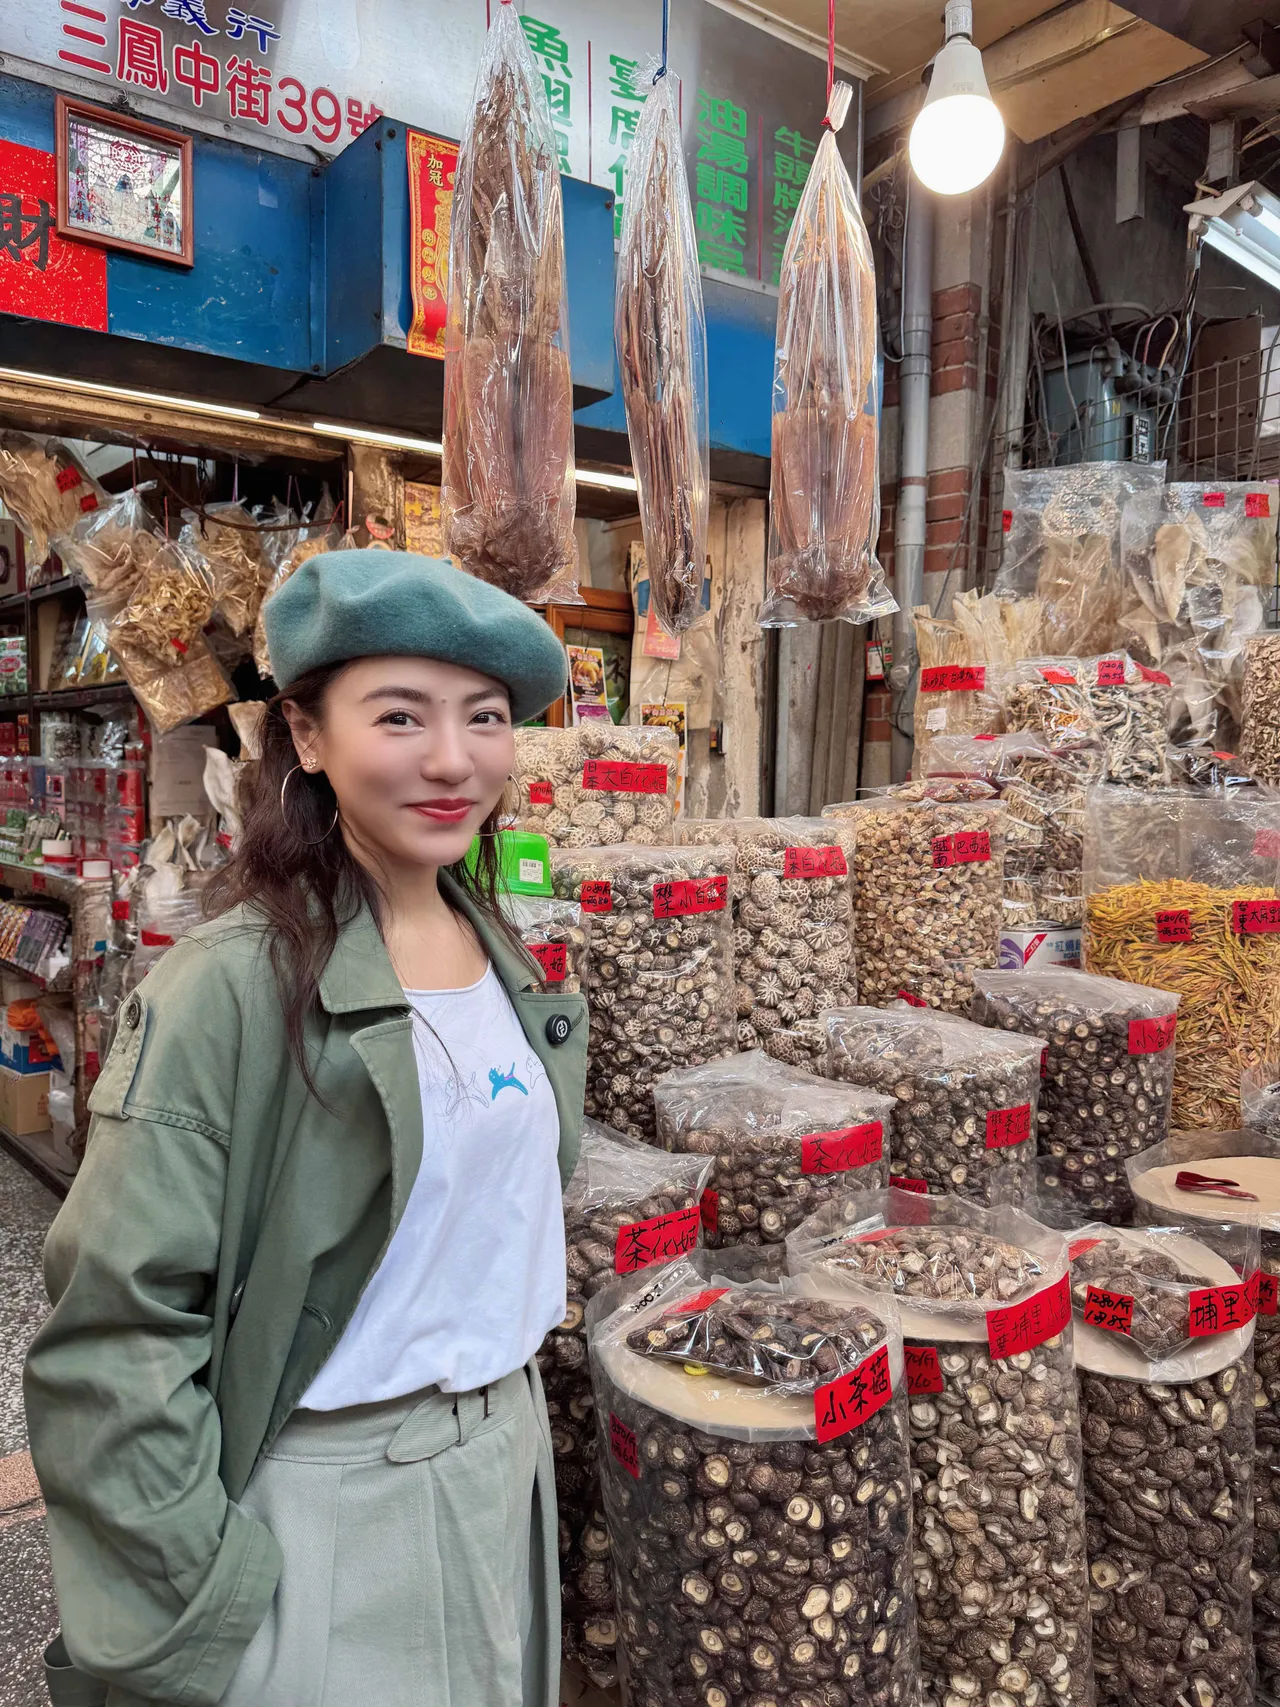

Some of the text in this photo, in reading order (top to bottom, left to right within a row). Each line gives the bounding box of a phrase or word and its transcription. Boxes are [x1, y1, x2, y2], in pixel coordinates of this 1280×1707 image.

[121, 0, 282, 53] 義行
[426, 153, 444, 188] 加冠
[809, 1129, 881, 1172] 茶花菇
[620, 1209, 698, 1269] 茶花菇
